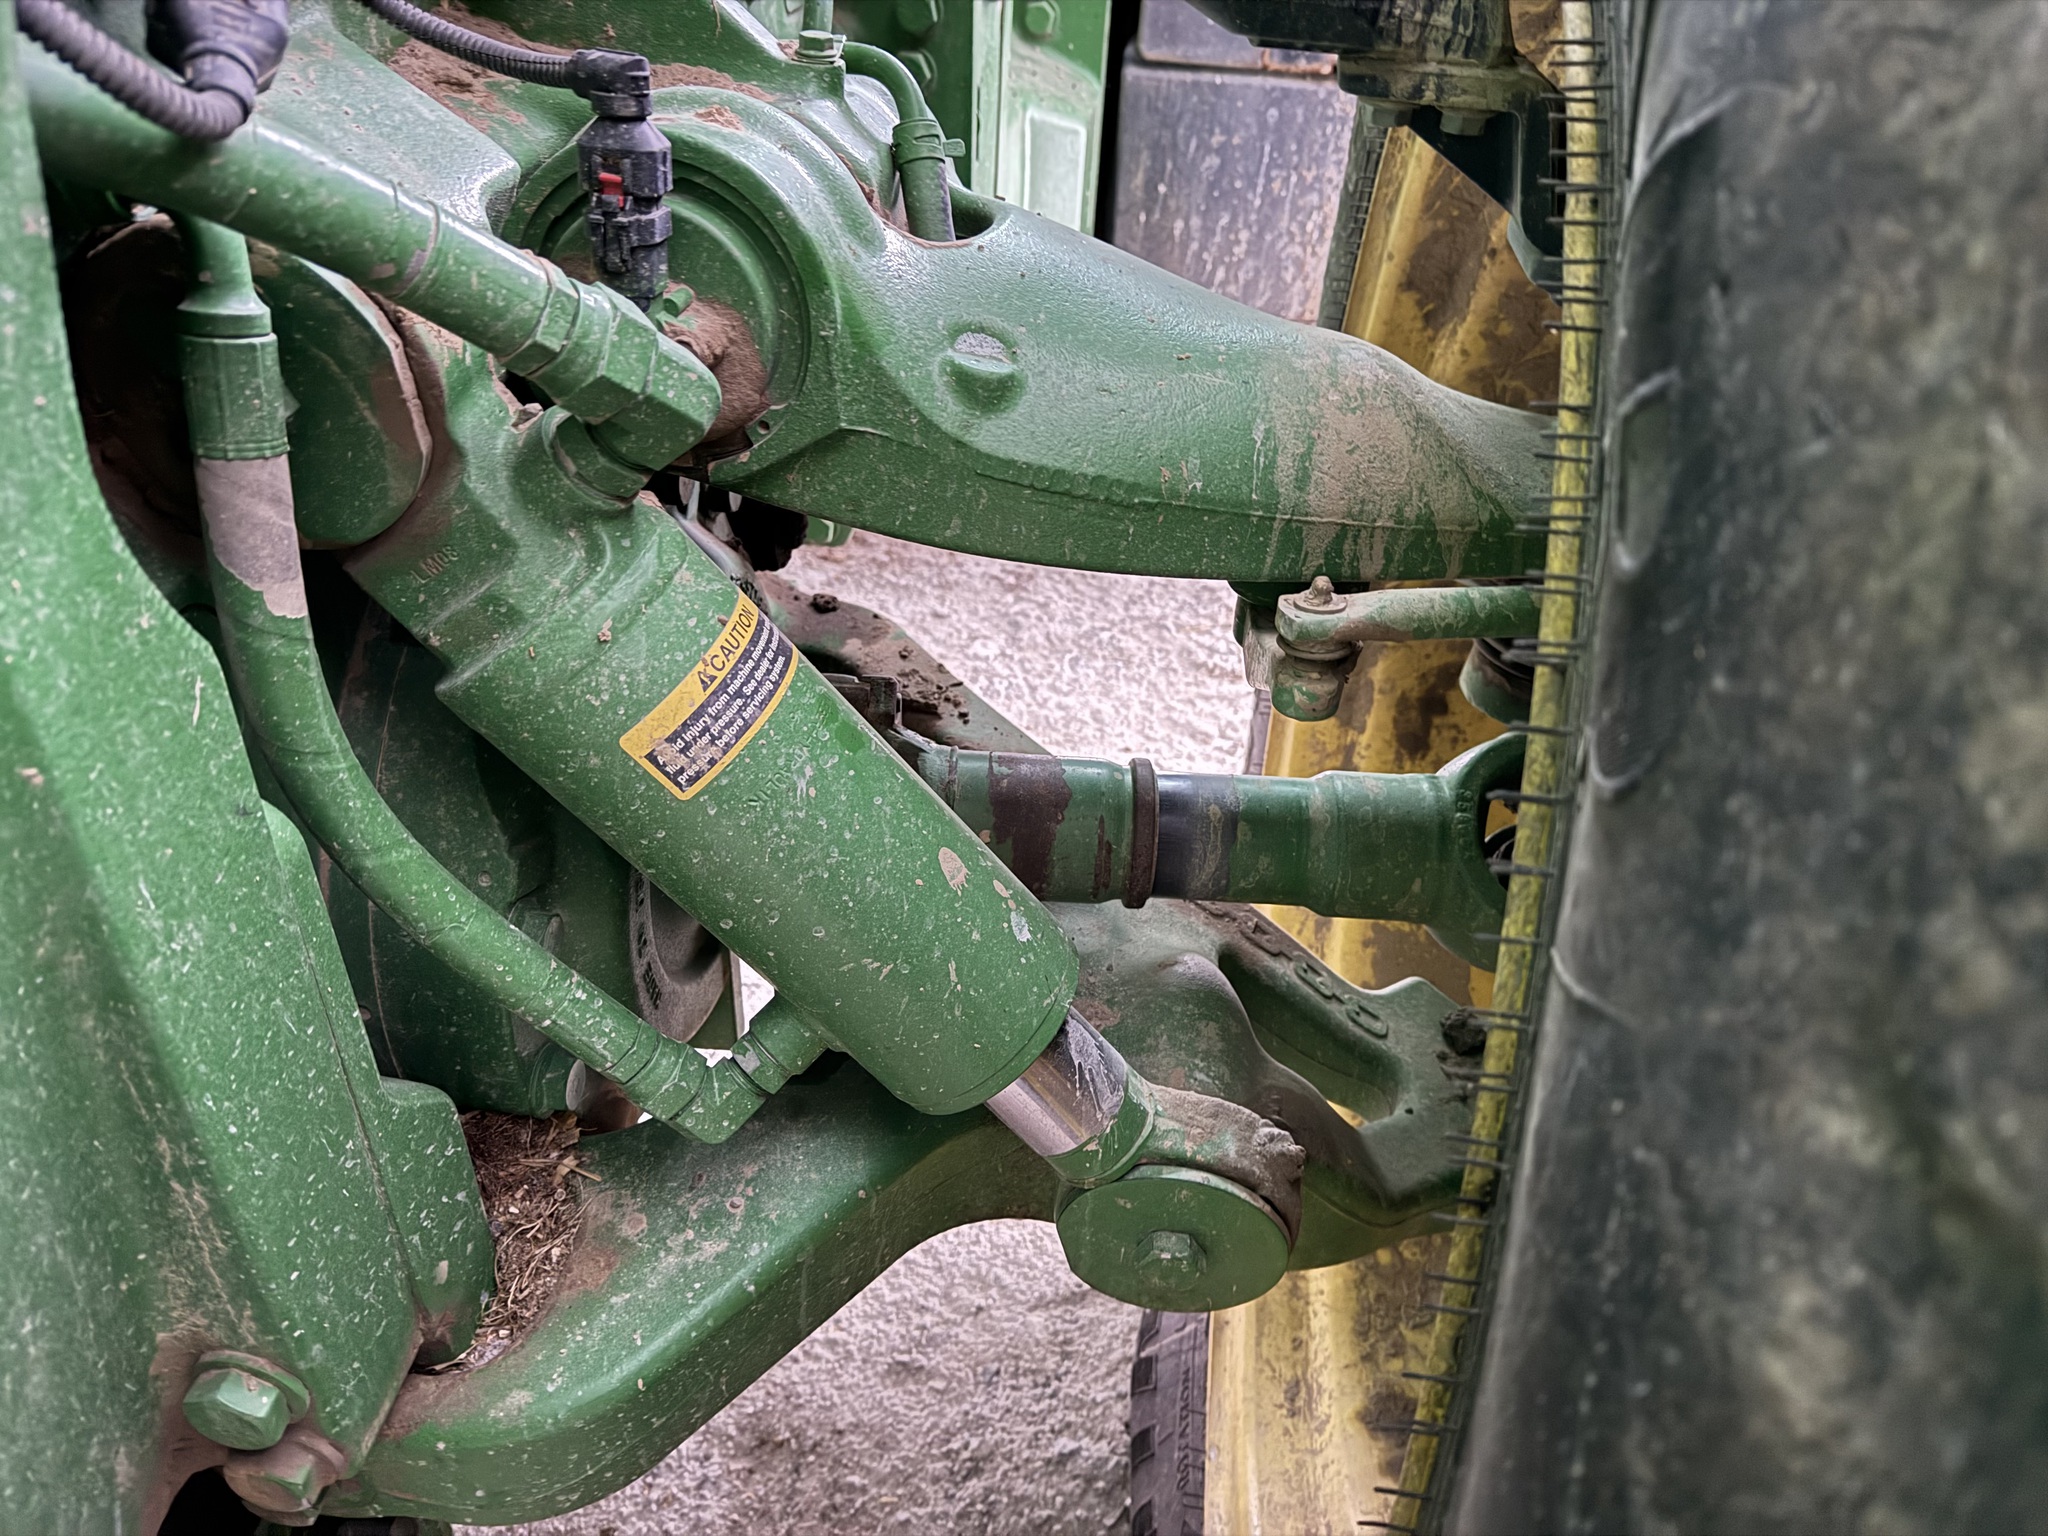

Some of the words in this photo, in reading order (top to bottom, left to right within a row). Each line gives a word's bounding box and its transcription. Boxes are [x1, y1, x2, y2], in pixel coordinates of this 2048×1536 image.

[710, 604, 755, 671] CAUTION
[656, 737, 685, 766] Aoid
[707, 693, 730, 717] from
[727, 659, 755, 695] machine
[664, 752, 689, 775] flud
[710, 697, 746, 737] pressure.
[742, 679, 758, 696] See
[754, 657, 770, 682] dealer
[765, 648, 775, 660] for
[677, 745, 718, 786] pressur
[715, 718, 745, 748] before
[742, 680, 774, 719] servicing
